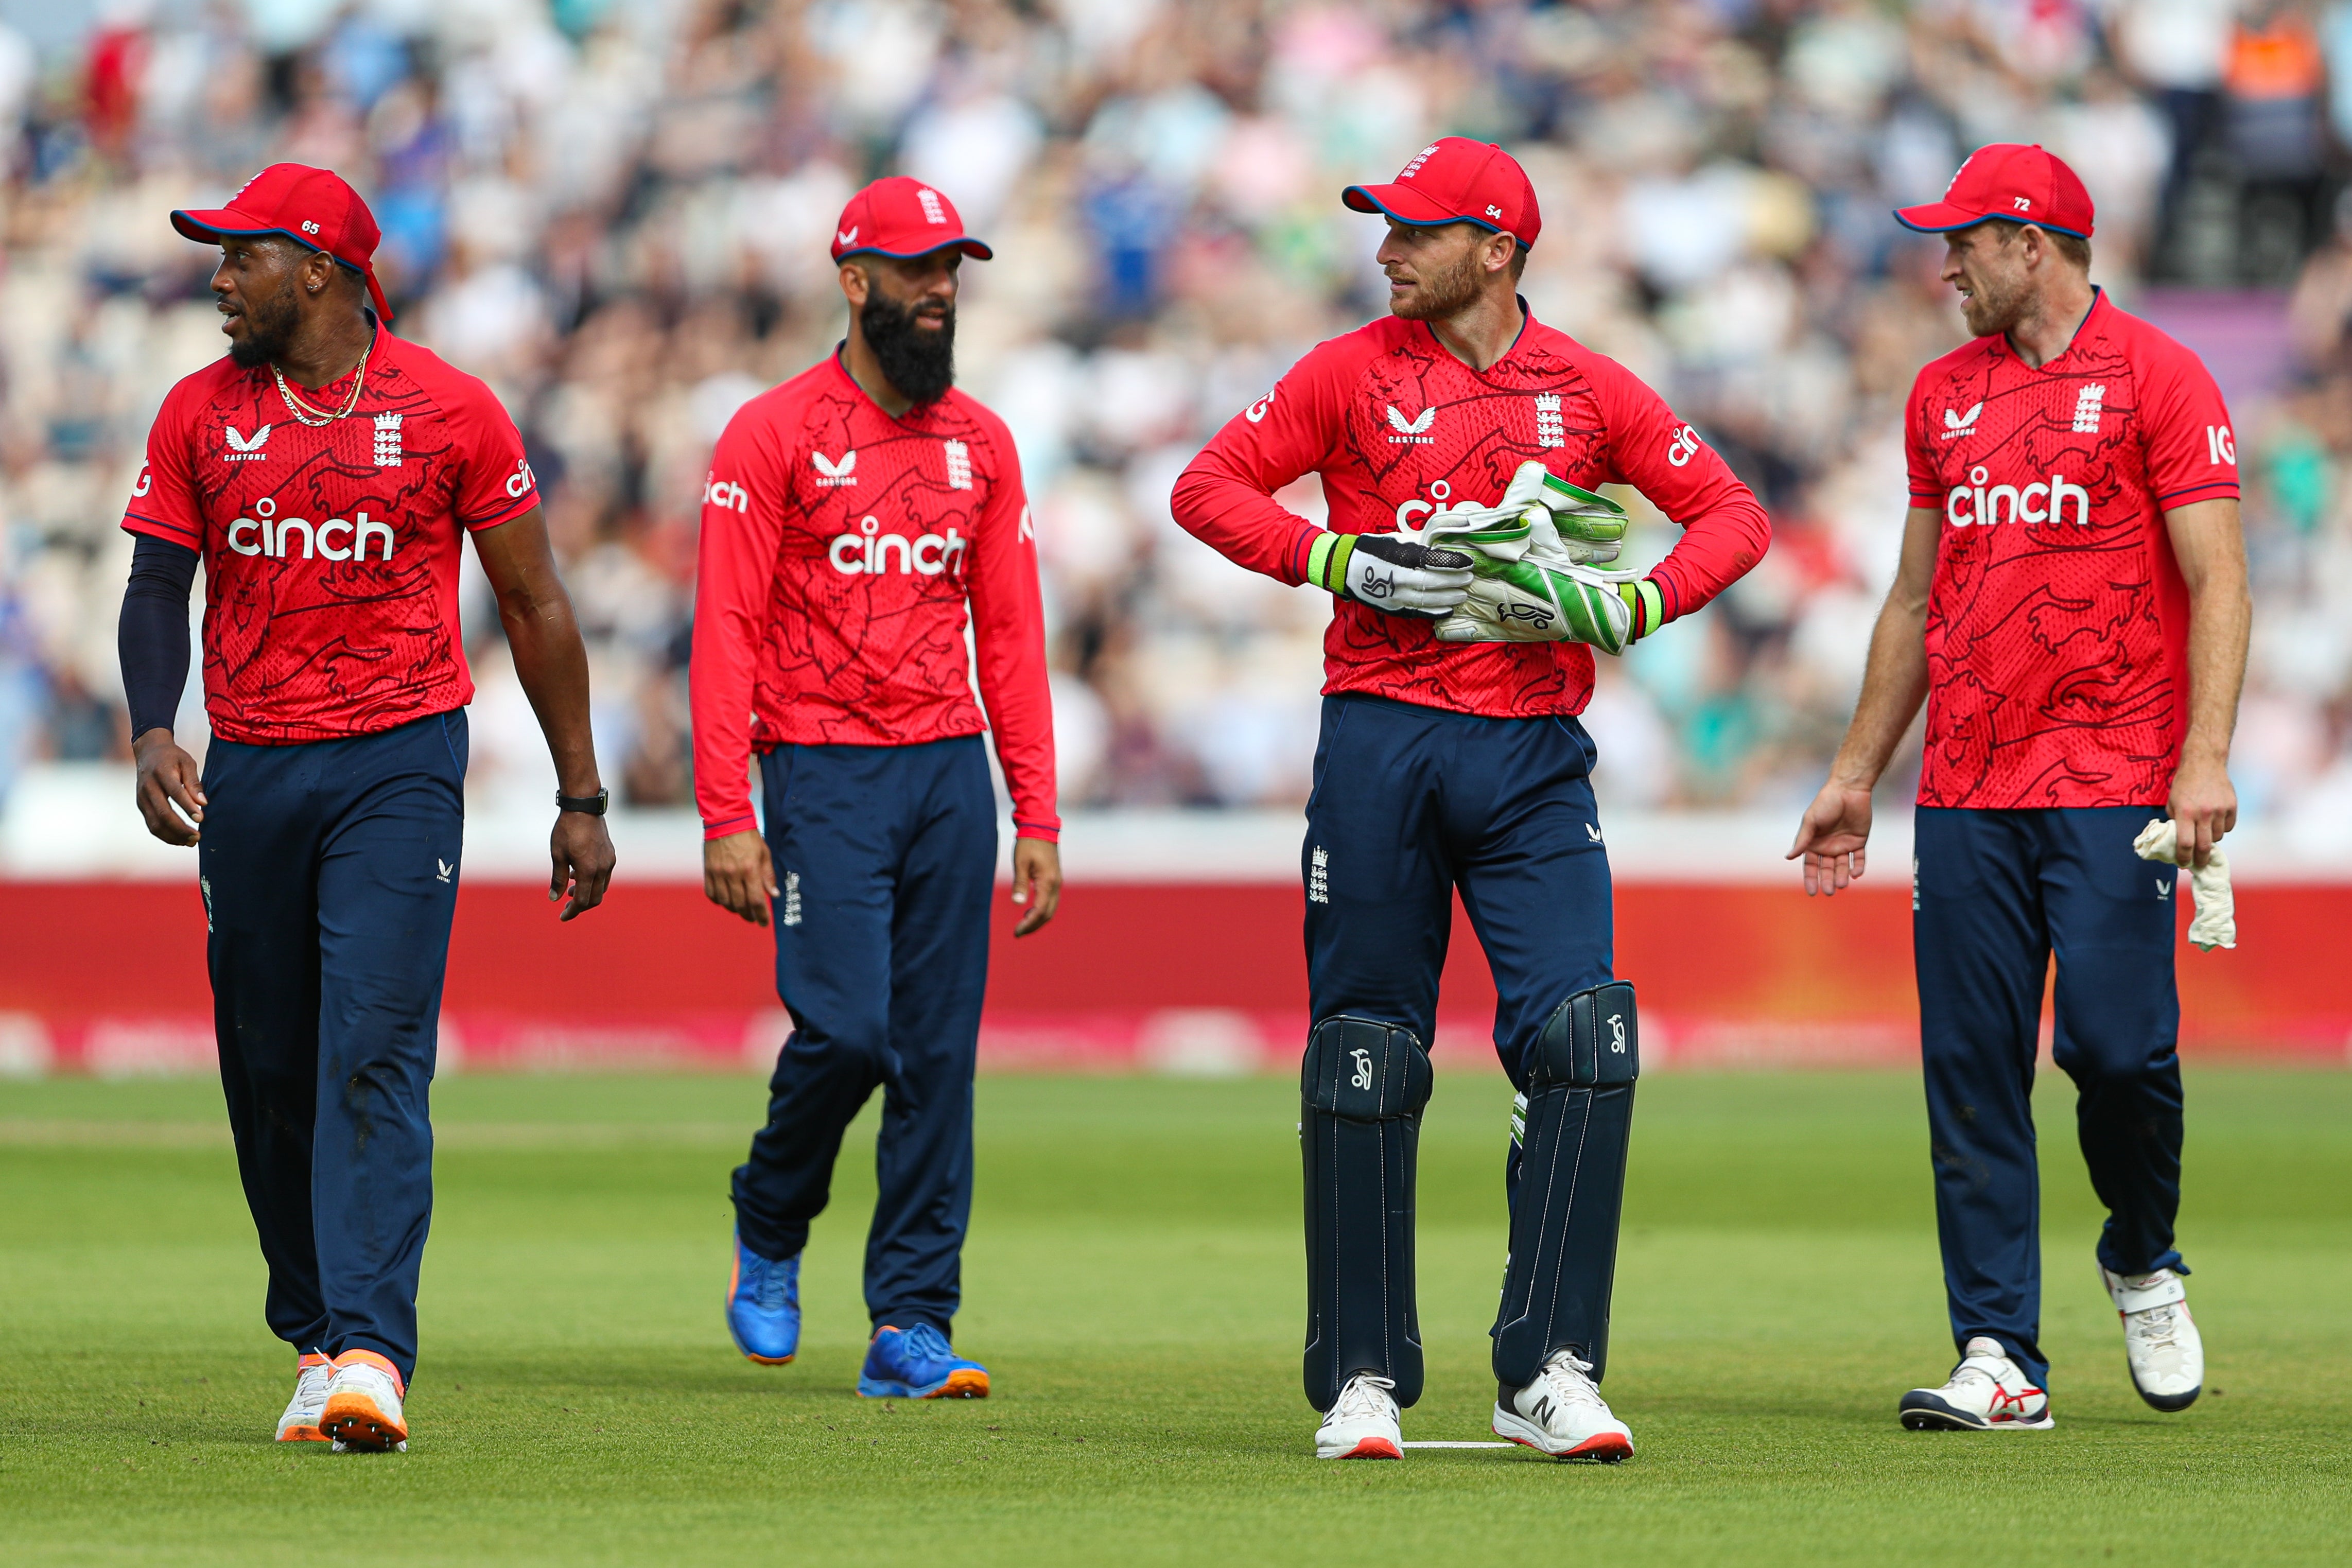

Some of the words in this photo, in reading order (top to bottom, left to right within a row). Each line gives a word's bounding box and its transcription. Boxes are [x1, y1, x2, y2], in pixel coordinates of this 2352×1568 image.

[1485, 204, 1502, 220] 54
[2013, 196, 2031, 212] 72
[302, 220, 320, 235] 65
[1388, 435, 1434, 444] CASTORE
[1941, 428, 1976, 440] CASTORE
[2207, 425, 2236, 466] IG
[223, 453, 267, 462] CASTORE
[816, 477, 858, 487] CASTORE
[1948, 465, 2089, 527] cinch
[228, 497, 395, 561] cinch
[829, 515, 967, 576] cinch
